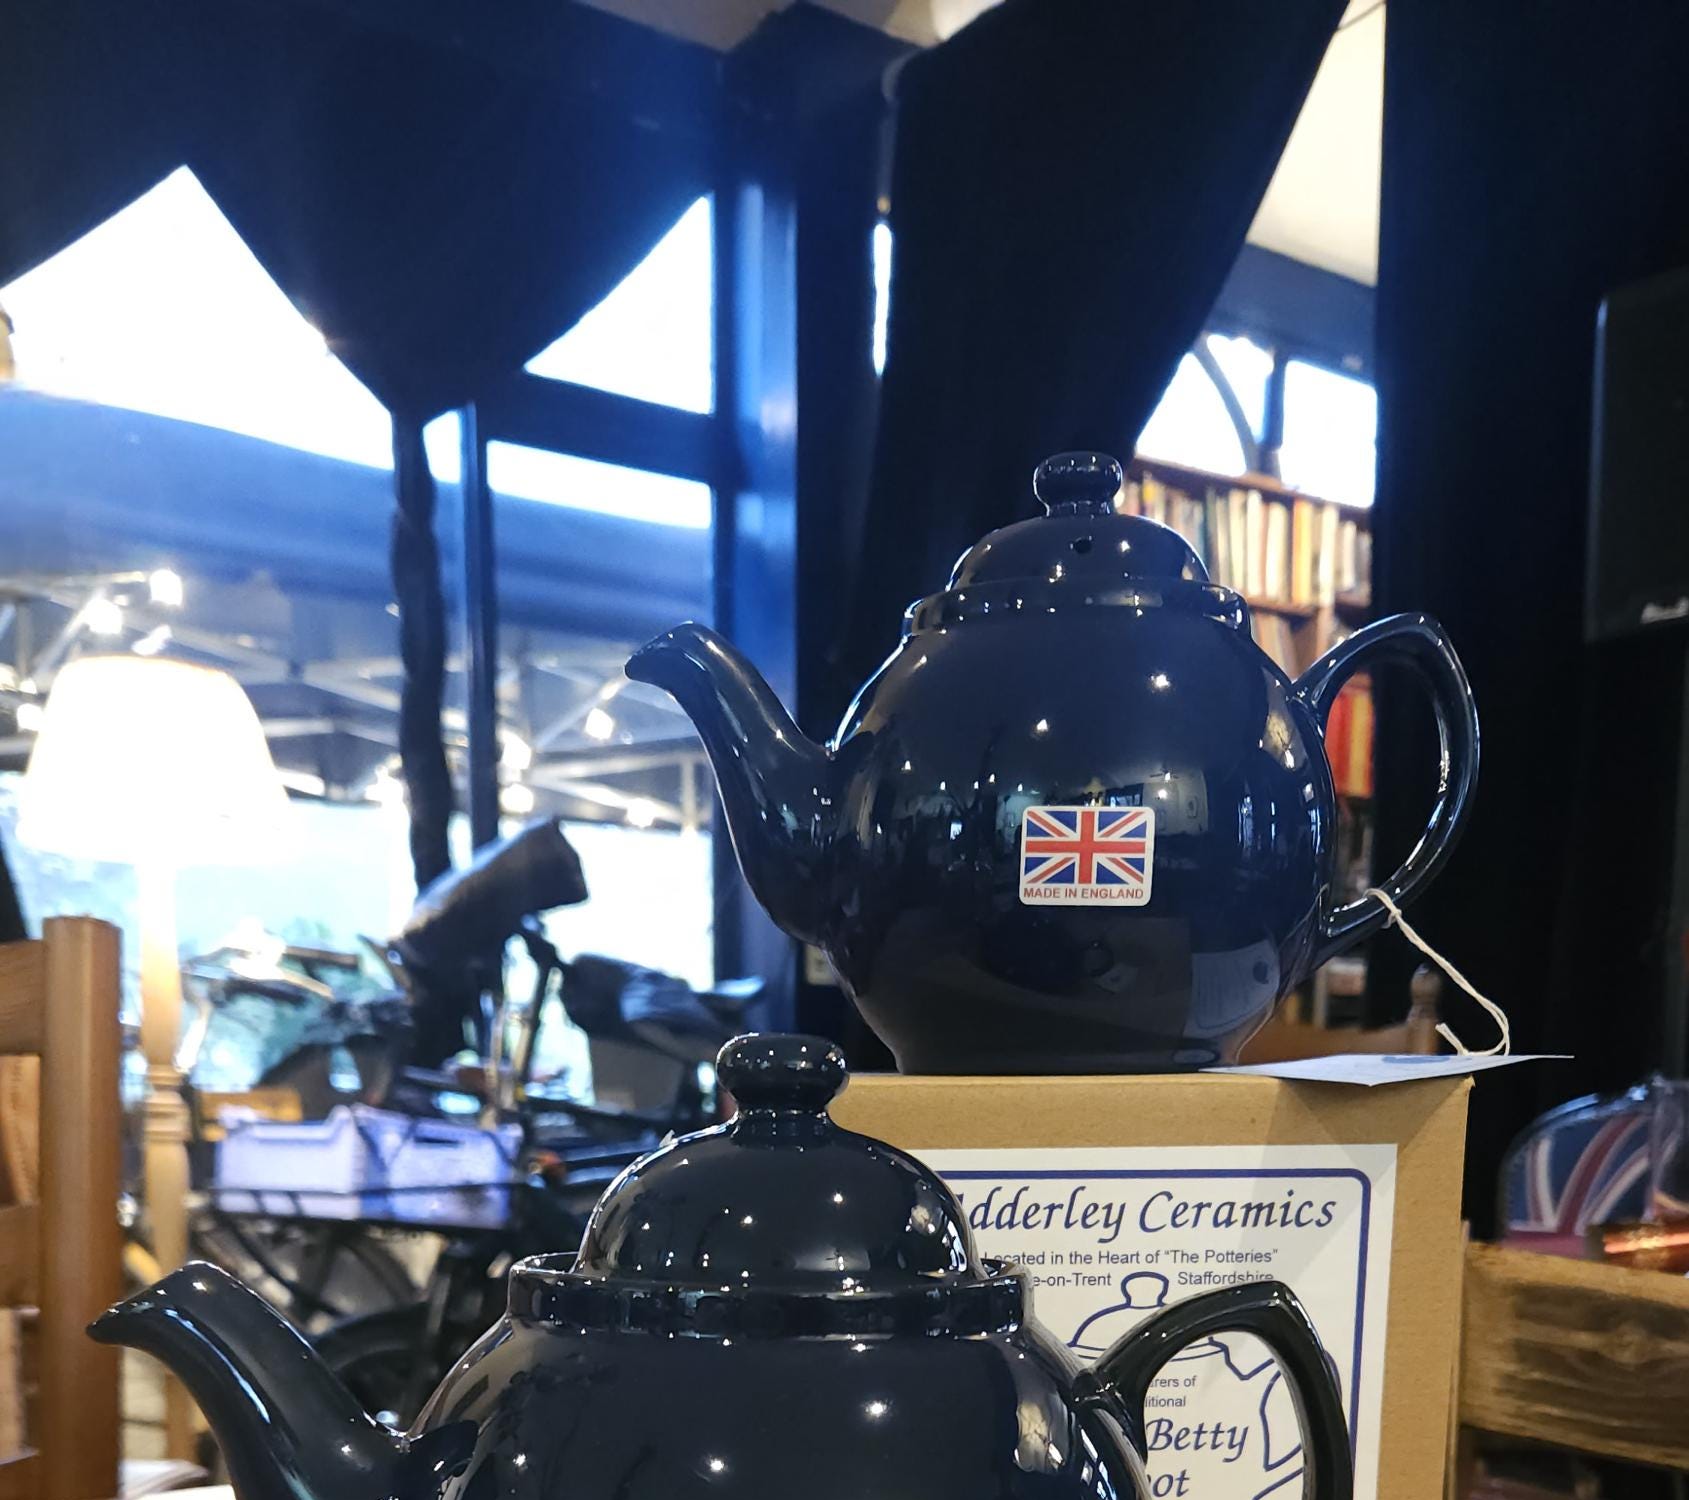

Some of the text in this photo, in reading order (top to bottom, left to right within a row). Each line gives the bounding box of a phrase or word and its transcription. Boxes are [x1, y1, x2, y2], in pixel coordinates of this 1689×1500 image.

[1023, 887, 1144, 899] MADE IN ENGLAND
[957, 1186, 1336, 1243] dderley Ceramics
[1051, 1251, 1064, 1264] in
[1069, 1251, 1093, 1264] the
[1098, 1250, 1141, 1264] Heart
[1145, 1250, 1160, 1263] of
[1183, 1374, 1197, 1388] of
[1146, 1418, 1249, 1463] Betty
[1147, 1469, 1190, 1498] ot
